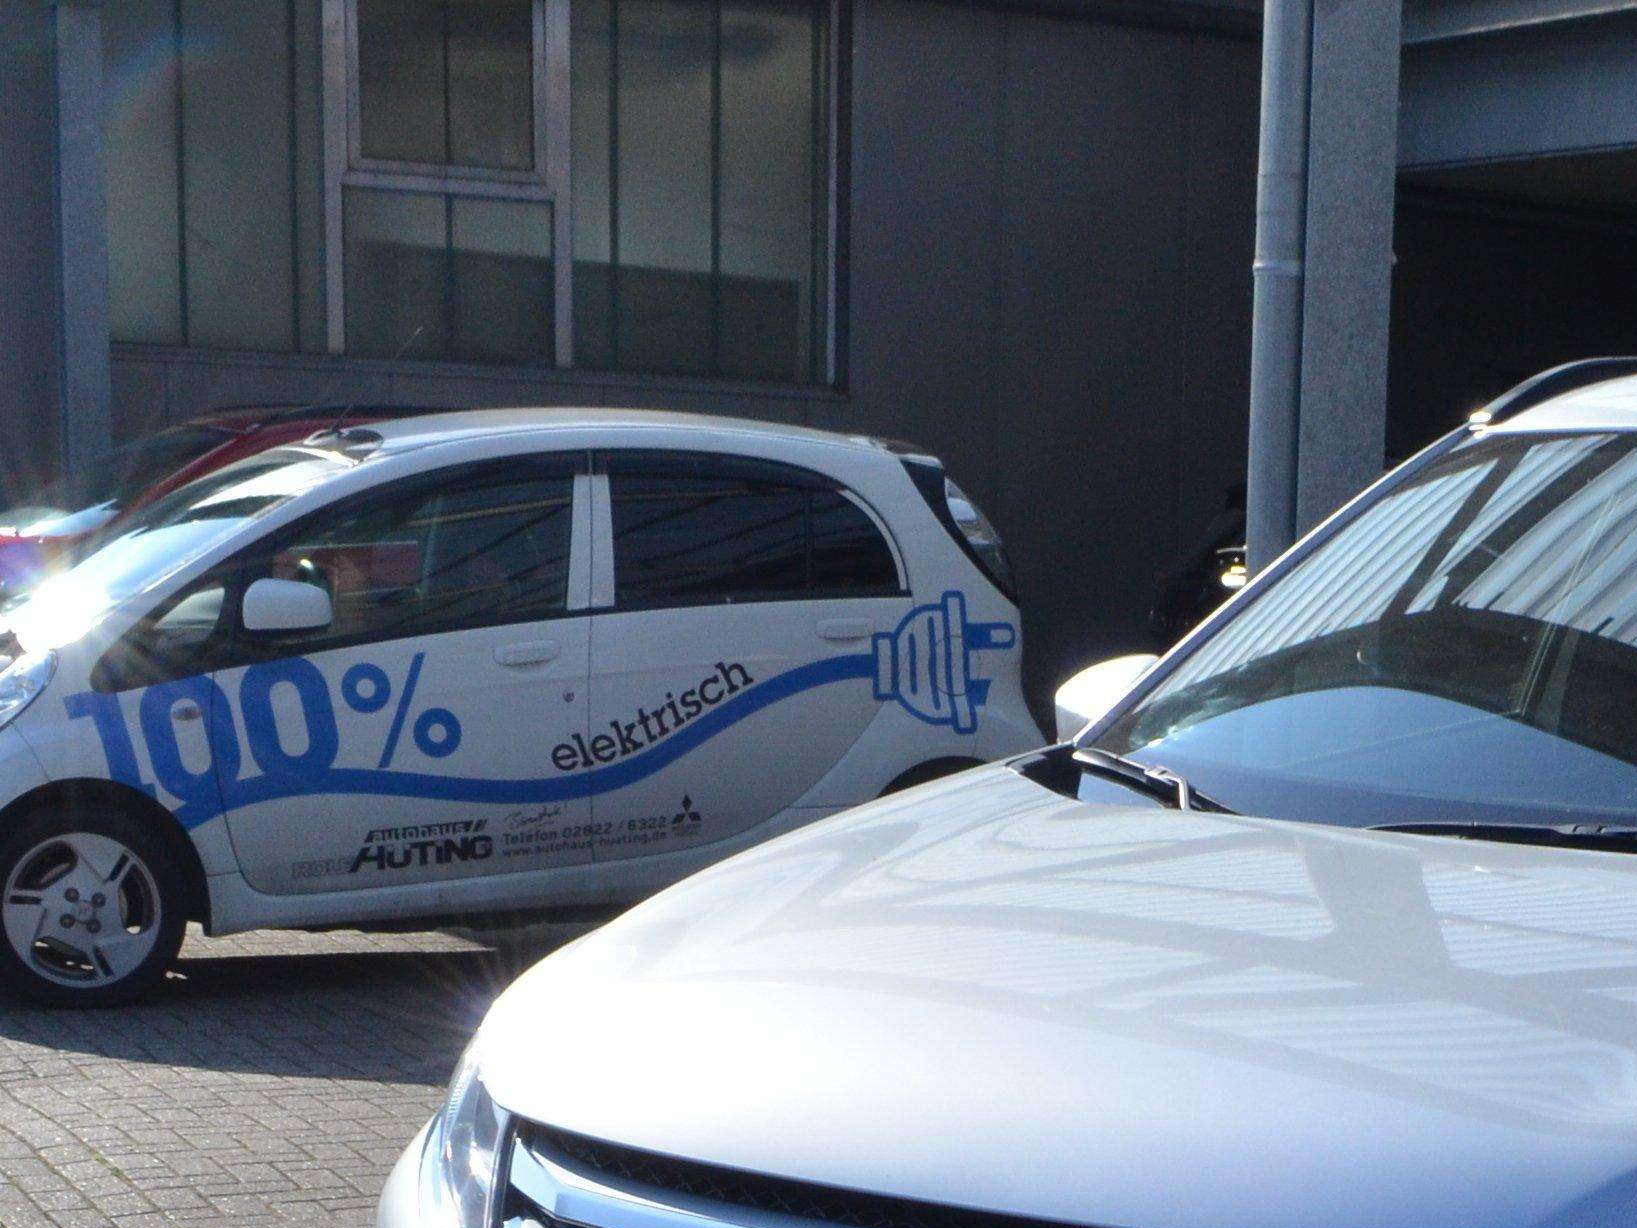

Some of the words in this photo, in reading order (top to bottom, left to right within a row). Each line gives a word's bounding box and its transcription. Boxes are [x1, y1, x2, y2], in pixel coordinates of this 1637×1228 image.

[63, 651, 463, 802] 100%
[551, 661, 755, 771] elektrisch
[502, 830, 558, 846] Telefon
[562, 822, 613, 839] 02822
[627, 815, 667, 831] 6322
